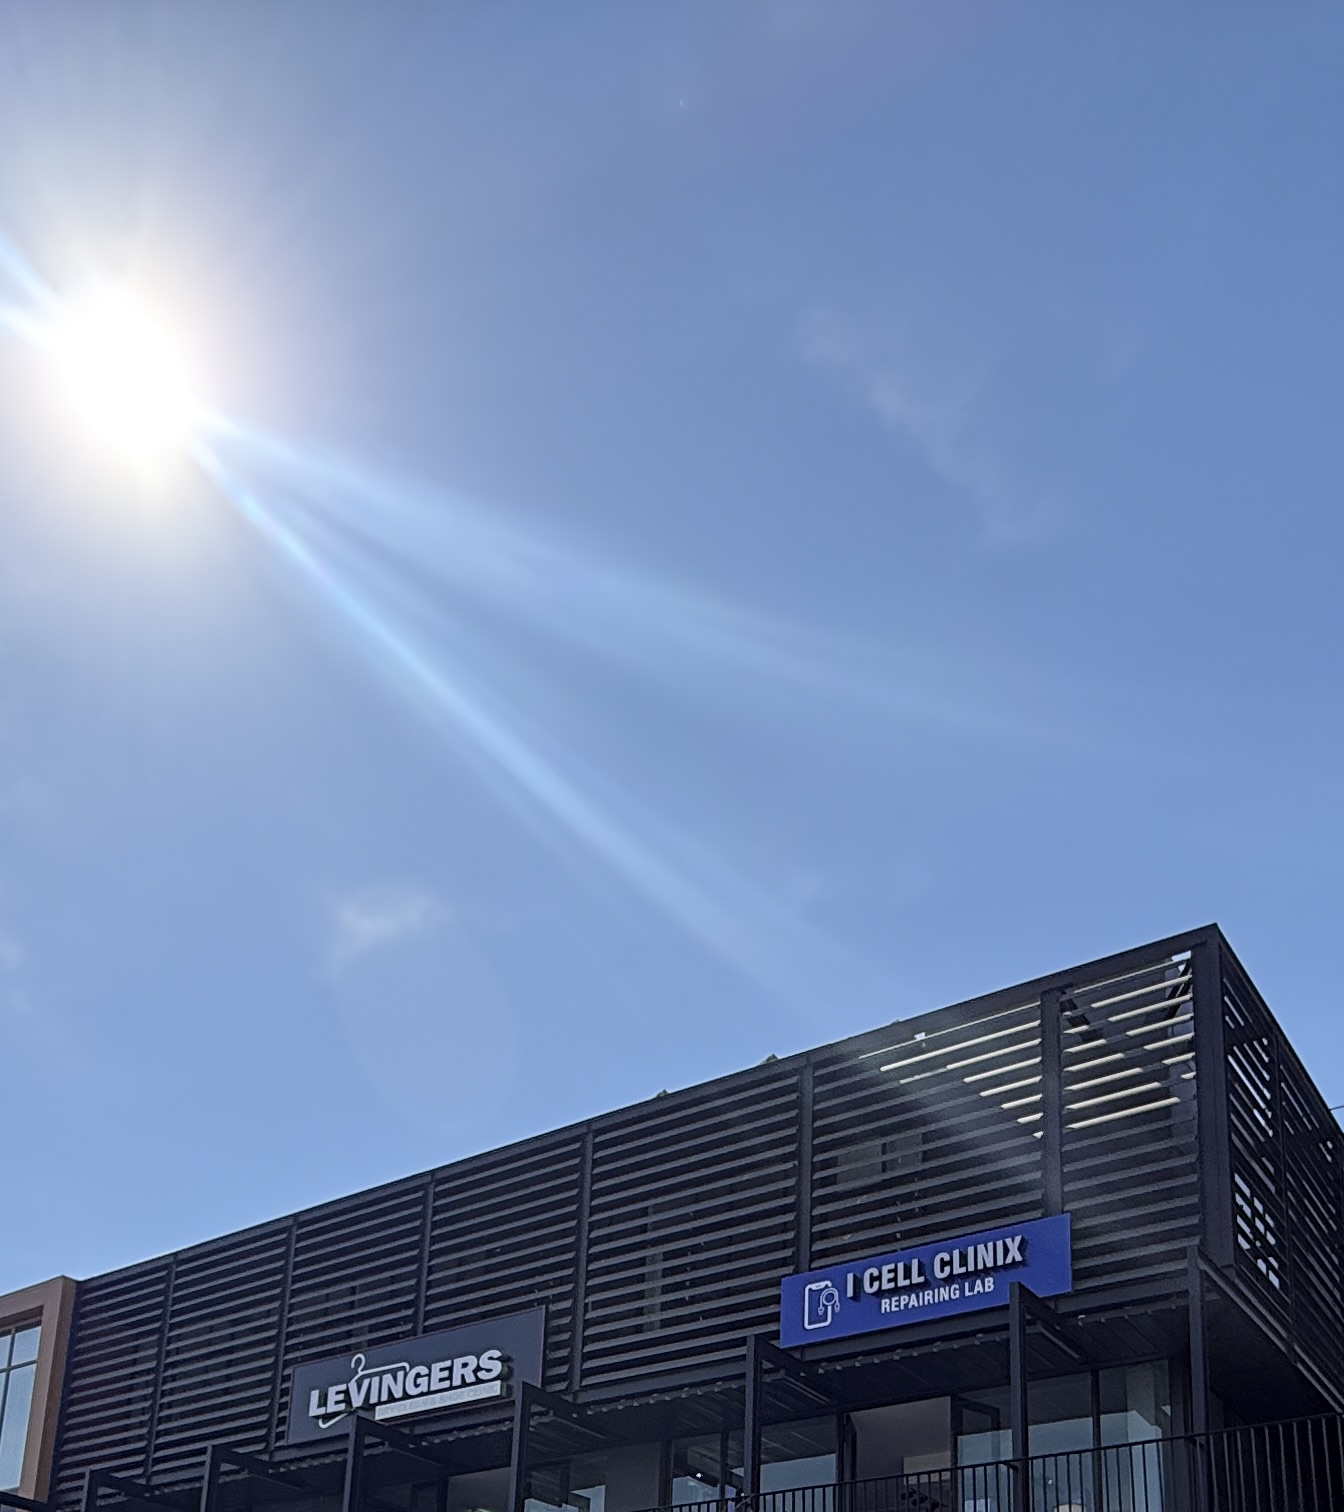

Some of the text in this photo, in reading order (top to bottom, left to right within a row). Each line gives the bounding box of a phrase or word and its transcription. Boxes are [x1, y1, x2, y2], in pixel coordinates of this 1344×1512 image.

[846, 1235, 1023, 1299] I CELL CLINIX
[881, 1276, 994, 1314] REPAIRING LAB
[308, 1349, 503, 1417] LEVINGERS
